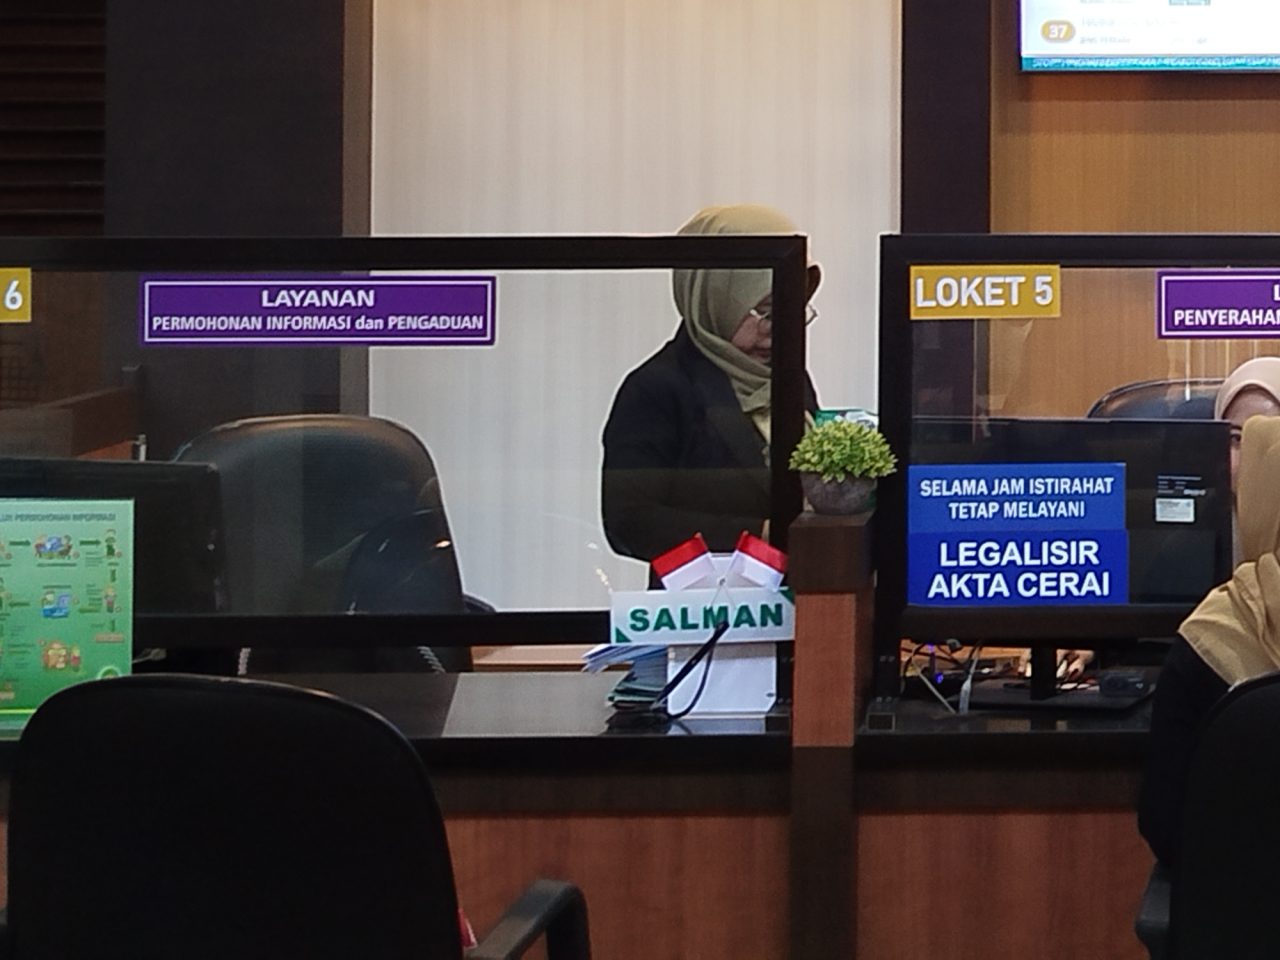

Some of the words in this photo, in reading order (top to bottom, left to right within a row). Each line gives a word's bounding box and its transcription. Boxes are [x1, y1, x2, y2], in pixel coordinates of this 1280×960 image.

[1050, 25, 1067, 39] 37
[4, 280, 23, 311] 6
[261, 290, 374, 307] LAYANAN
[915, 277, 1025, 307] LOKET
[1035, 276, 1053, 305] 5
[152, 315, 262, 330] PERMOHONAN
[266, 315, 351, 330] INFORMASI
[355, 314, 384, 330] dan
[387, 314, 483, 330] PENGADUAN
[920, 480, 988, 497] SELAMA
[991, 479, 1025, 496] JAM
[1029, 477, 1114, 495] ISTIRAHAT
[949, 501, 999, 520] TETAP
[1003, 500, 1085, 518] MELAYANI
[940, 540, 1100, 567] LEGALISIR
[927, 573, 1010, 598] AKTA
[1017, 571, 1110, 597] CERAI
[630, 603, 783, 631] SALMAN
